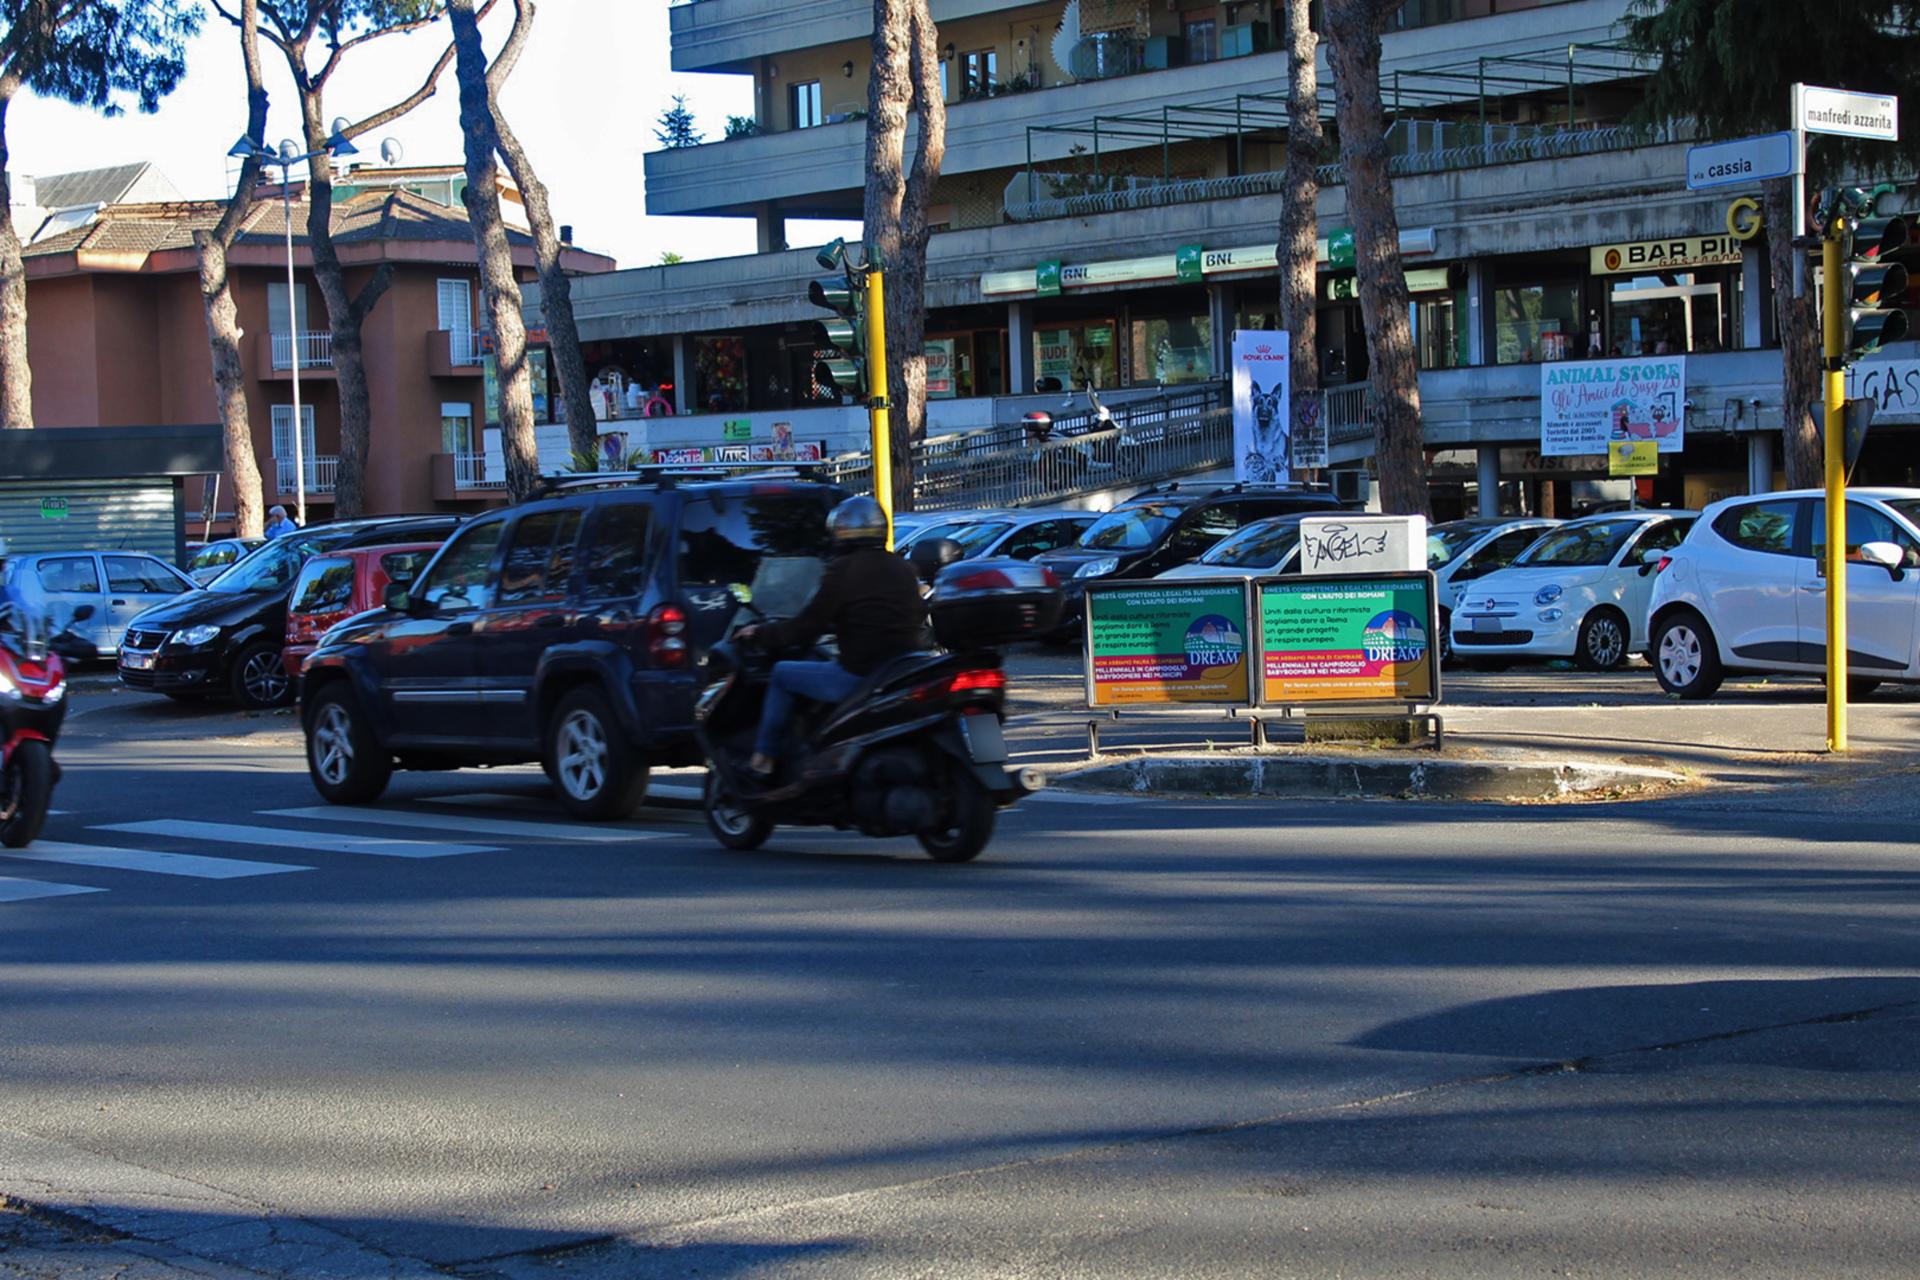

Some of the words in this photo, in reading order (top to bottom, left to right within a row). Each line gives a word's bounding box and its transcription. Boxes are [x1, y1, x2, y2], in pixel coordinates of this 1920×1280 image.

[1880, 100, 1890, 108] via
[1807, 107, 1851, 125] manfredi
[1854, 114, 1893, 130] azzarita
[1693, 172, 1704, 180] via
[1708, 157, 1752, 178] cassia
[1629, 242, 1687, 263] BAR
[1206, 253, 1235, 267] BNL
[1063, 268, 1091, 281] BNL
[1546, 367, 1616, 385] ANIMAL
[1619, 364, 1680, 381] STORE
[1575, 384, 1611, 408] Amici
[1611, 381, 1625, 398] di
[716, 447, 747, 463] VANS
[1291, 584, 1339, 592] COMPETENZA
[1117, 591, 1161, 599] COMPETENZA
[1301, 592, 1317, 600] CON
[1345, 591, 1356, 599] DEI
[1358, 590, 1385, 598] ROMANI
[1332, 606, 1371, 614] riformista
[1265, 618, 1299, 626] vogliamo
[1277, 627, 1304, 636] grande
[1306, 626, 1340, 635] progetto
[1190, 651, 1239, 665] DREAM
[1369, 647, 1420, 661] DREAM
[1266, 661, 1309, 669] MILLENNIALS
[1319, 660, 1366, 668] CAMPIDOGLIO
[1266, 668, 1316, 676] BABYBOOMERS
